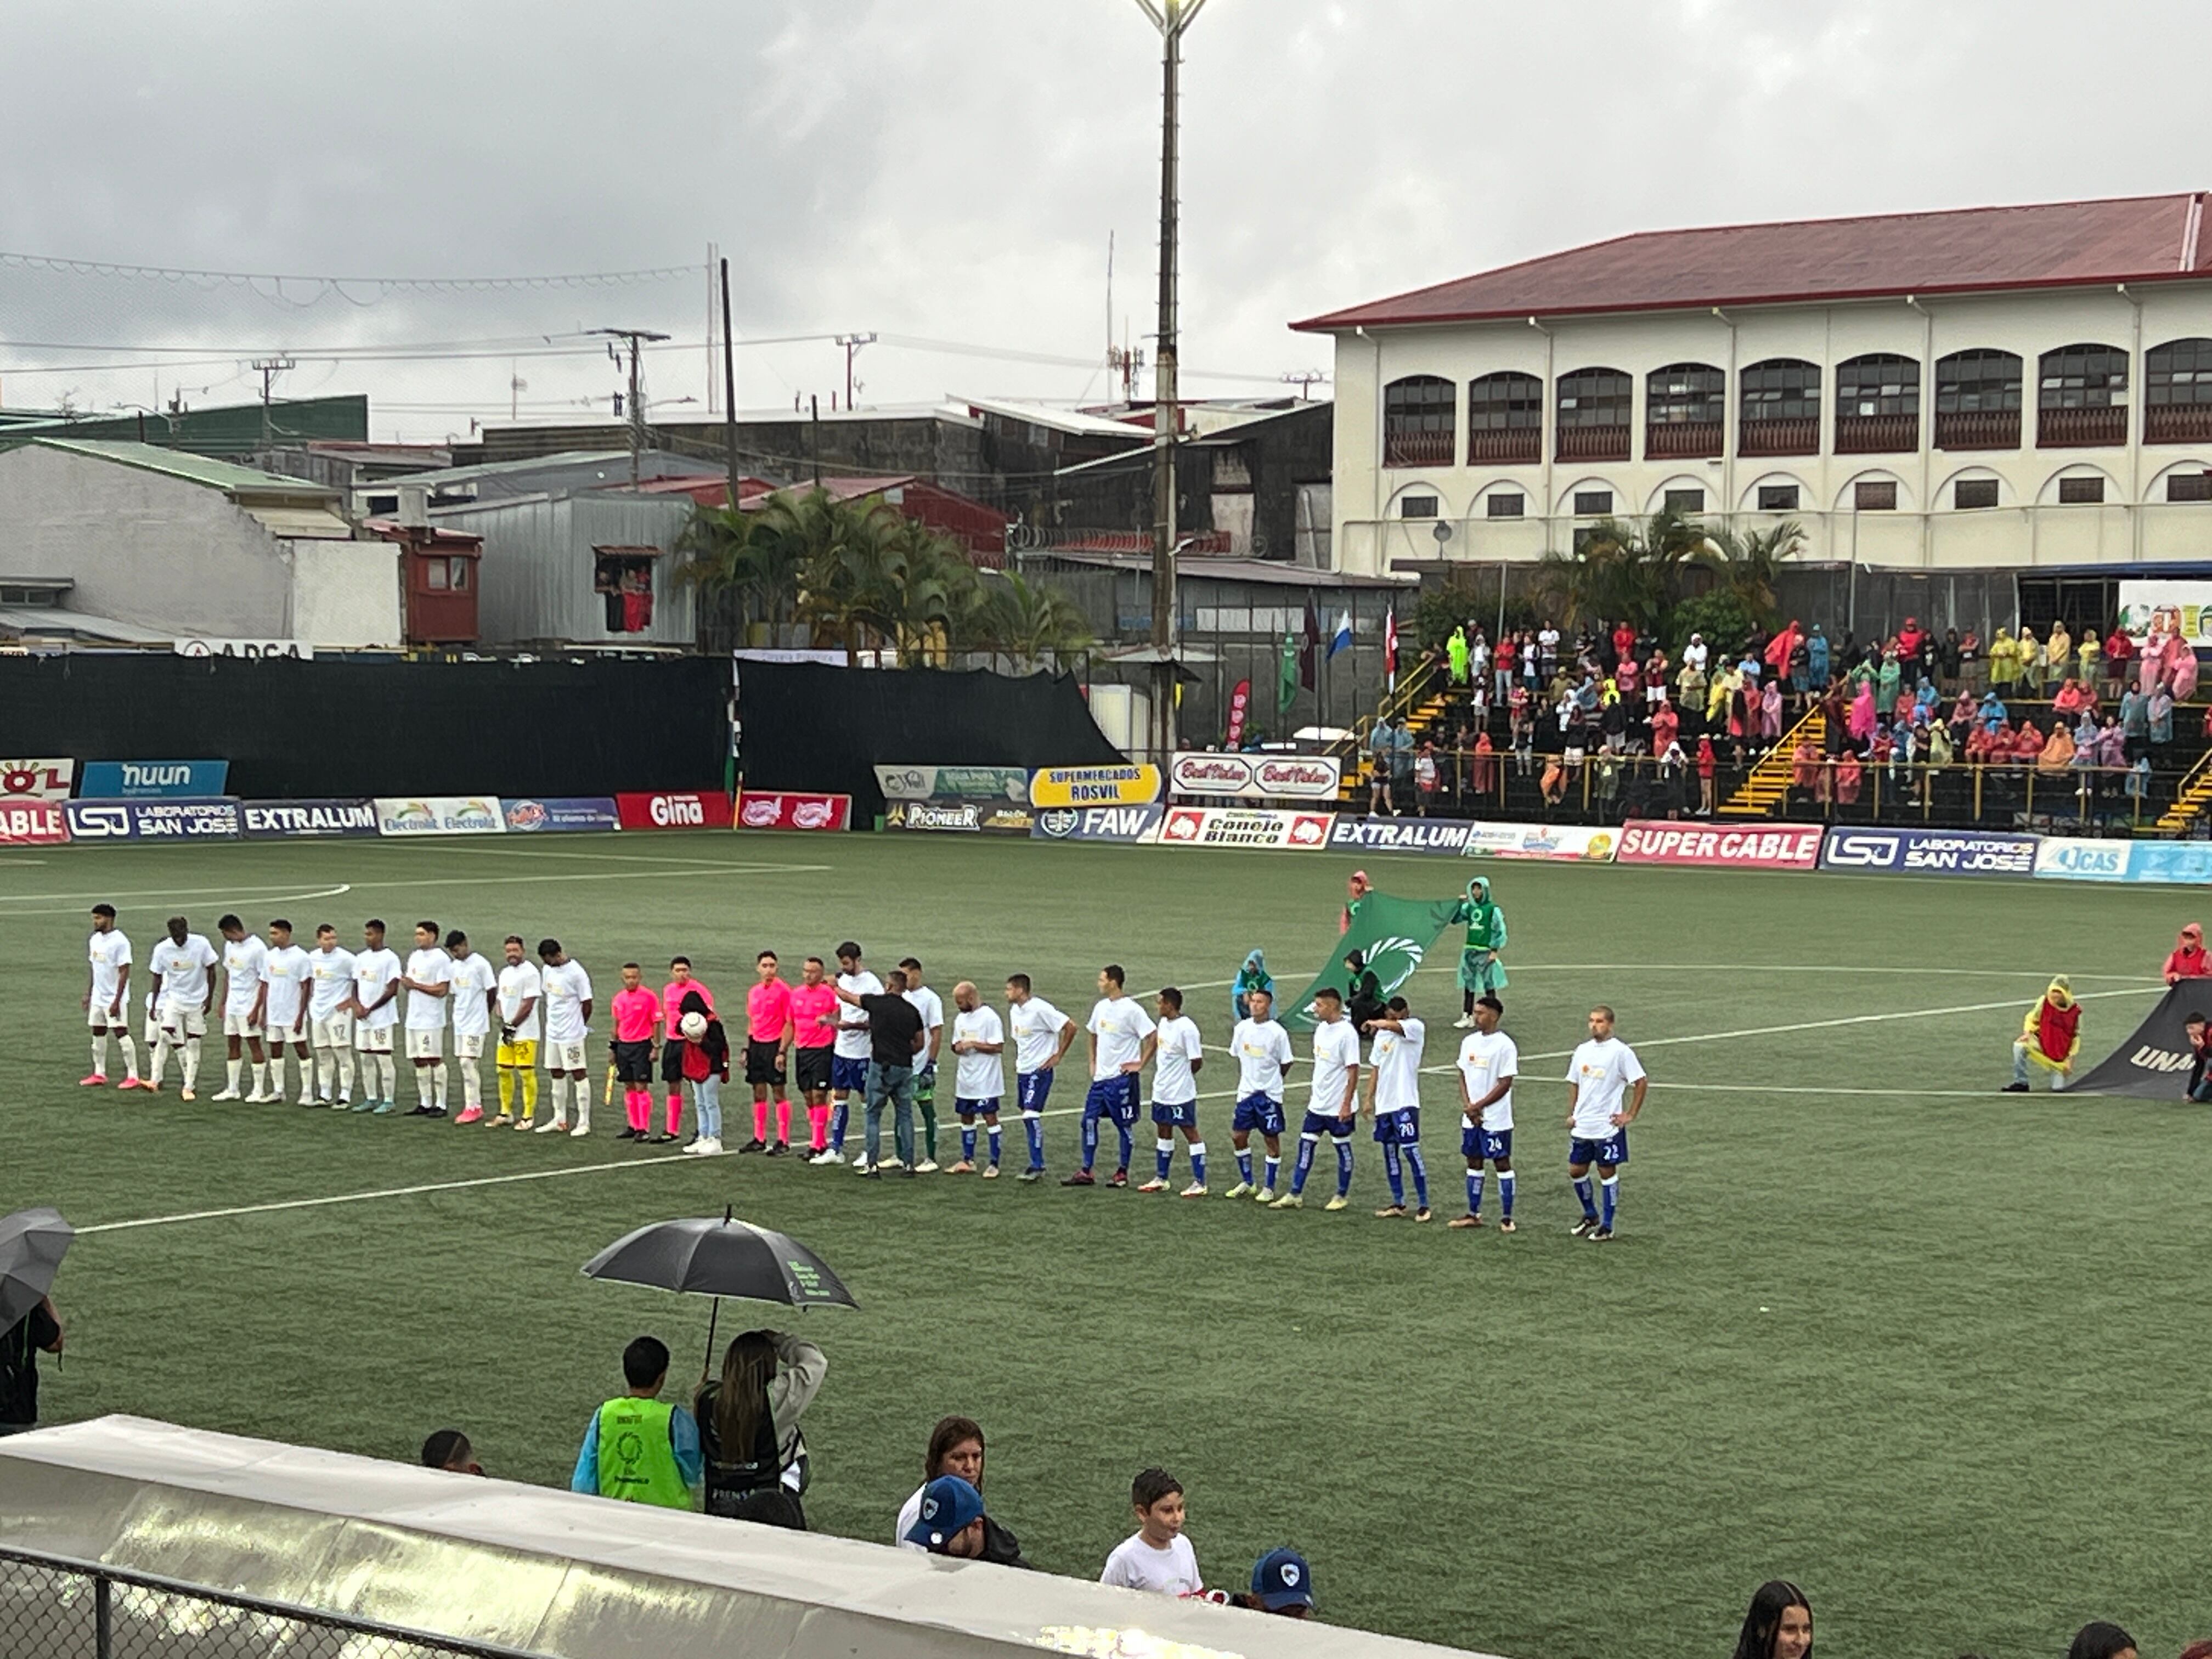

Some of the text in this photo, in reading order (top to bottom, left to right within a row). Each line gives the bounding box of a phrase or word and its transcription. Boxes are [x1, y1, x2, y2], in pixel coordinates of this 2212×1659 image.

[122, 764, 190, 786] nuun
[1049, 769, 1141, 783] SUPERMERCADOS
[1071, 785, 1120, 801] ROSVIL
[139, 819, 183, 835] SAN
[245, 806, 375, 830] EXTRALUM
[1083, 808, 1148, 834] FAW
[1333, 823, 1470, 847] EXTRALUM
[1621, 829, 1818, 860] SUPER CABLE
[1909, 838, 2034, 854] LABORATORIOS
[1904, 851, 1957, 868] SAN
